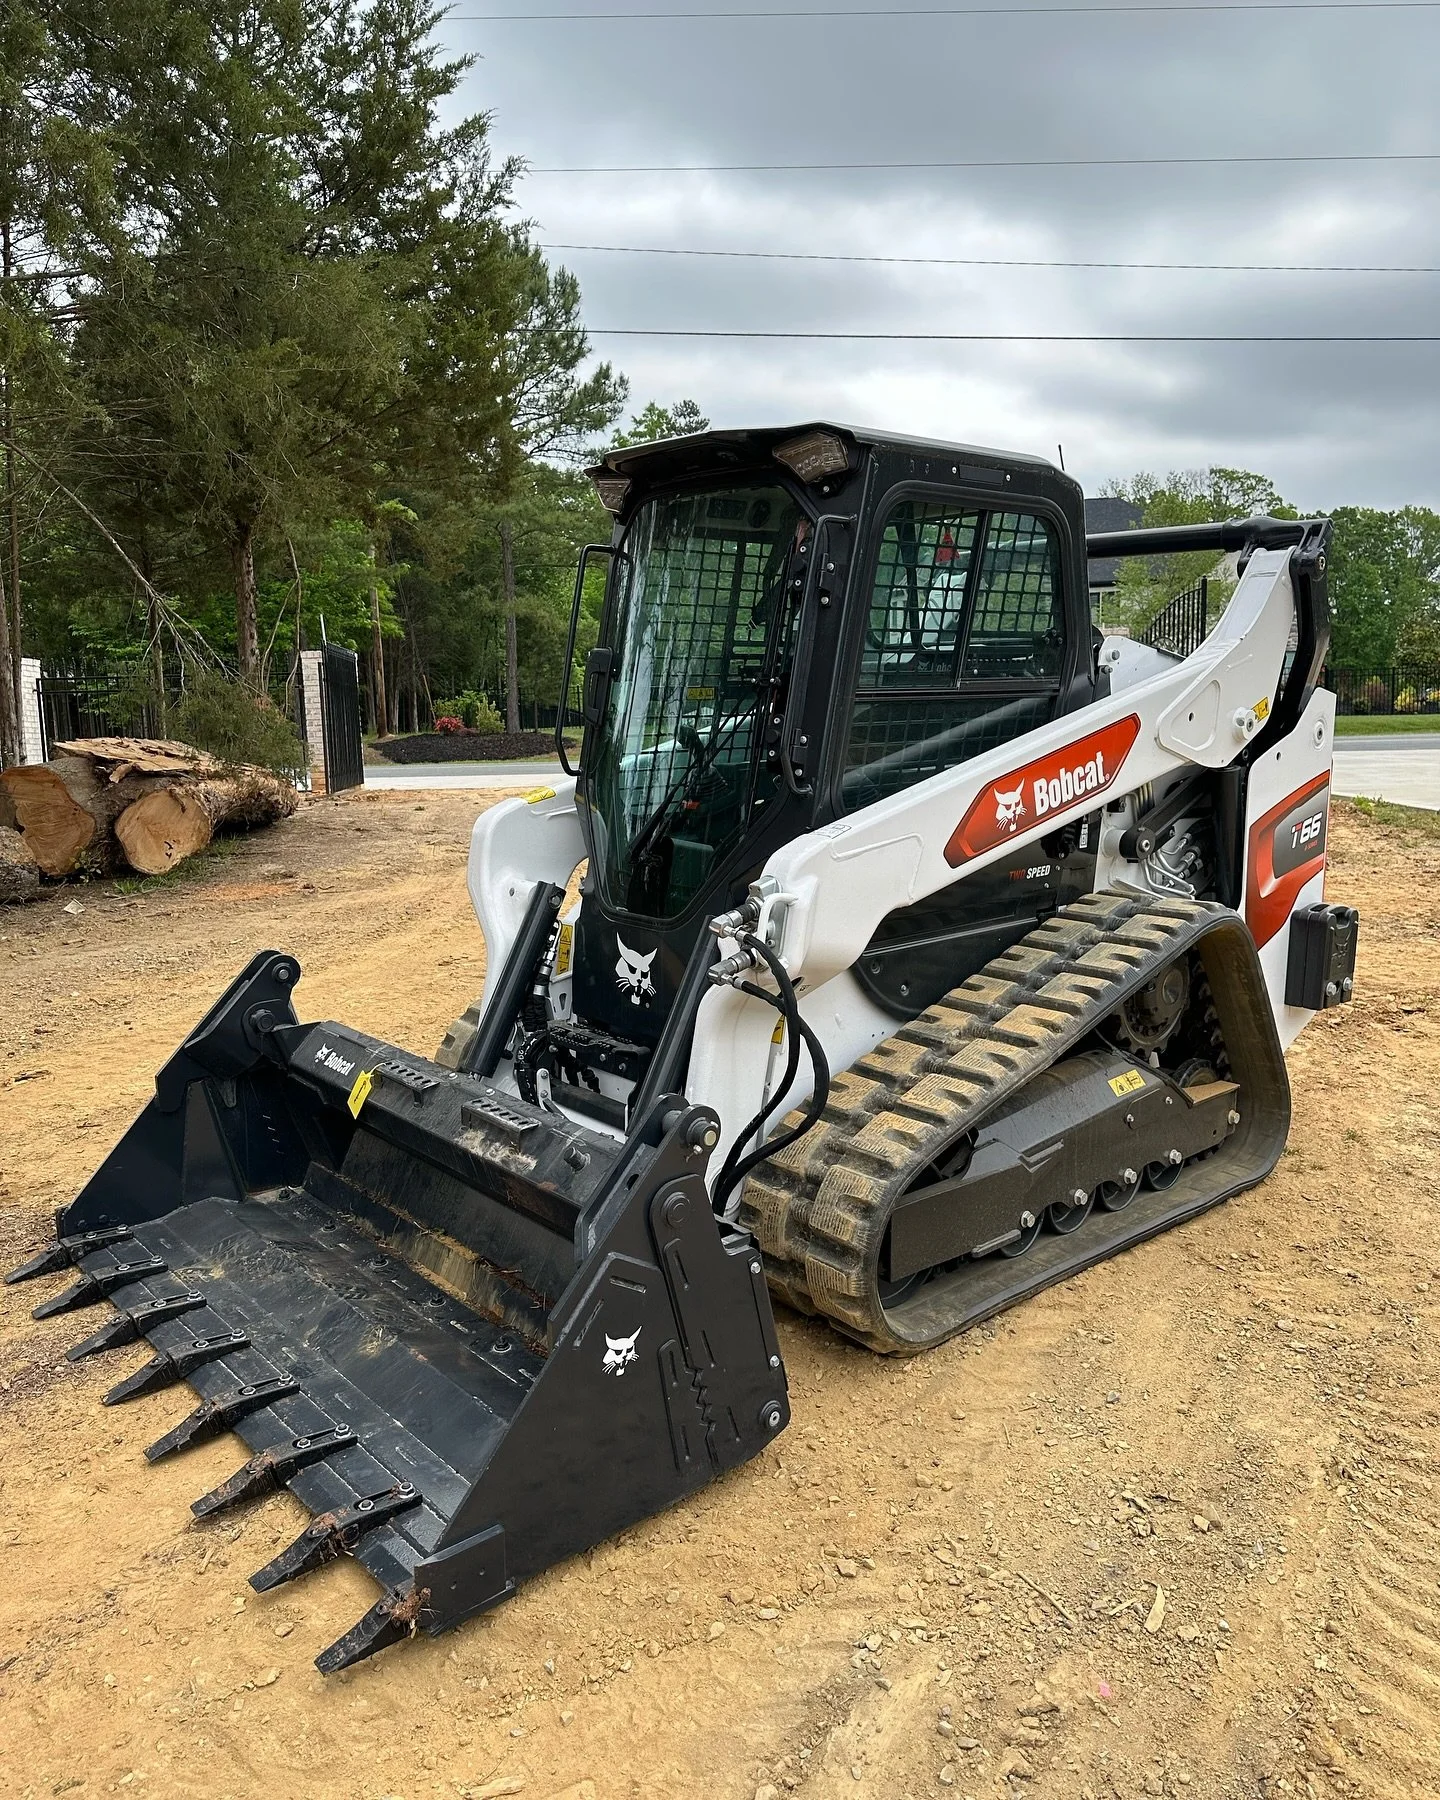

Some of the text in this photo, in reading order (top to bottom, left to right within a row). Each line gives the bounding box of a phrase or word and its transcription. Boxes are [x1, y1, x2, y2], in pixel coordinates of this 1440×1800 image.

[1033, 751, 1105, 816] Bobcat
[1291, 812, 1323, 849] T66
[1009, 864, 1051, 880] TWO SPEED
[323, 1051, 356, 1076] Bobcat
